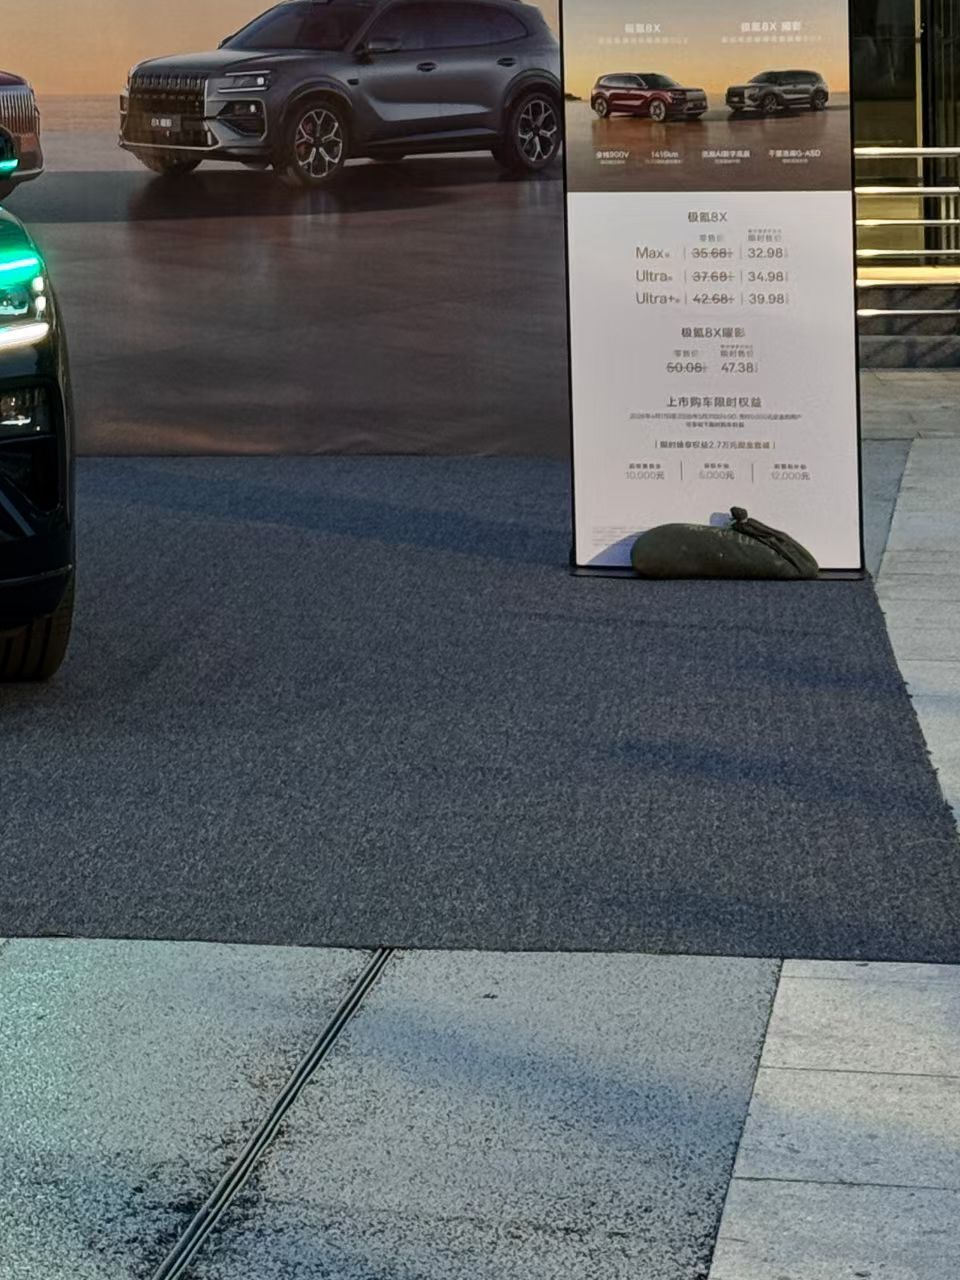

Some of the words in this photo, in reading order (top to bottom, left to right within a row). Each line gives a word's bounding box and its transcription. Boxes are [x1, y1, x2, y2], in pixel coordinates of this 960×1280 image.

[747, 247, 783, 259] 32.98
[747, 271, 784, 283] 34.98
[748, 293, 785, 305] 39.98
